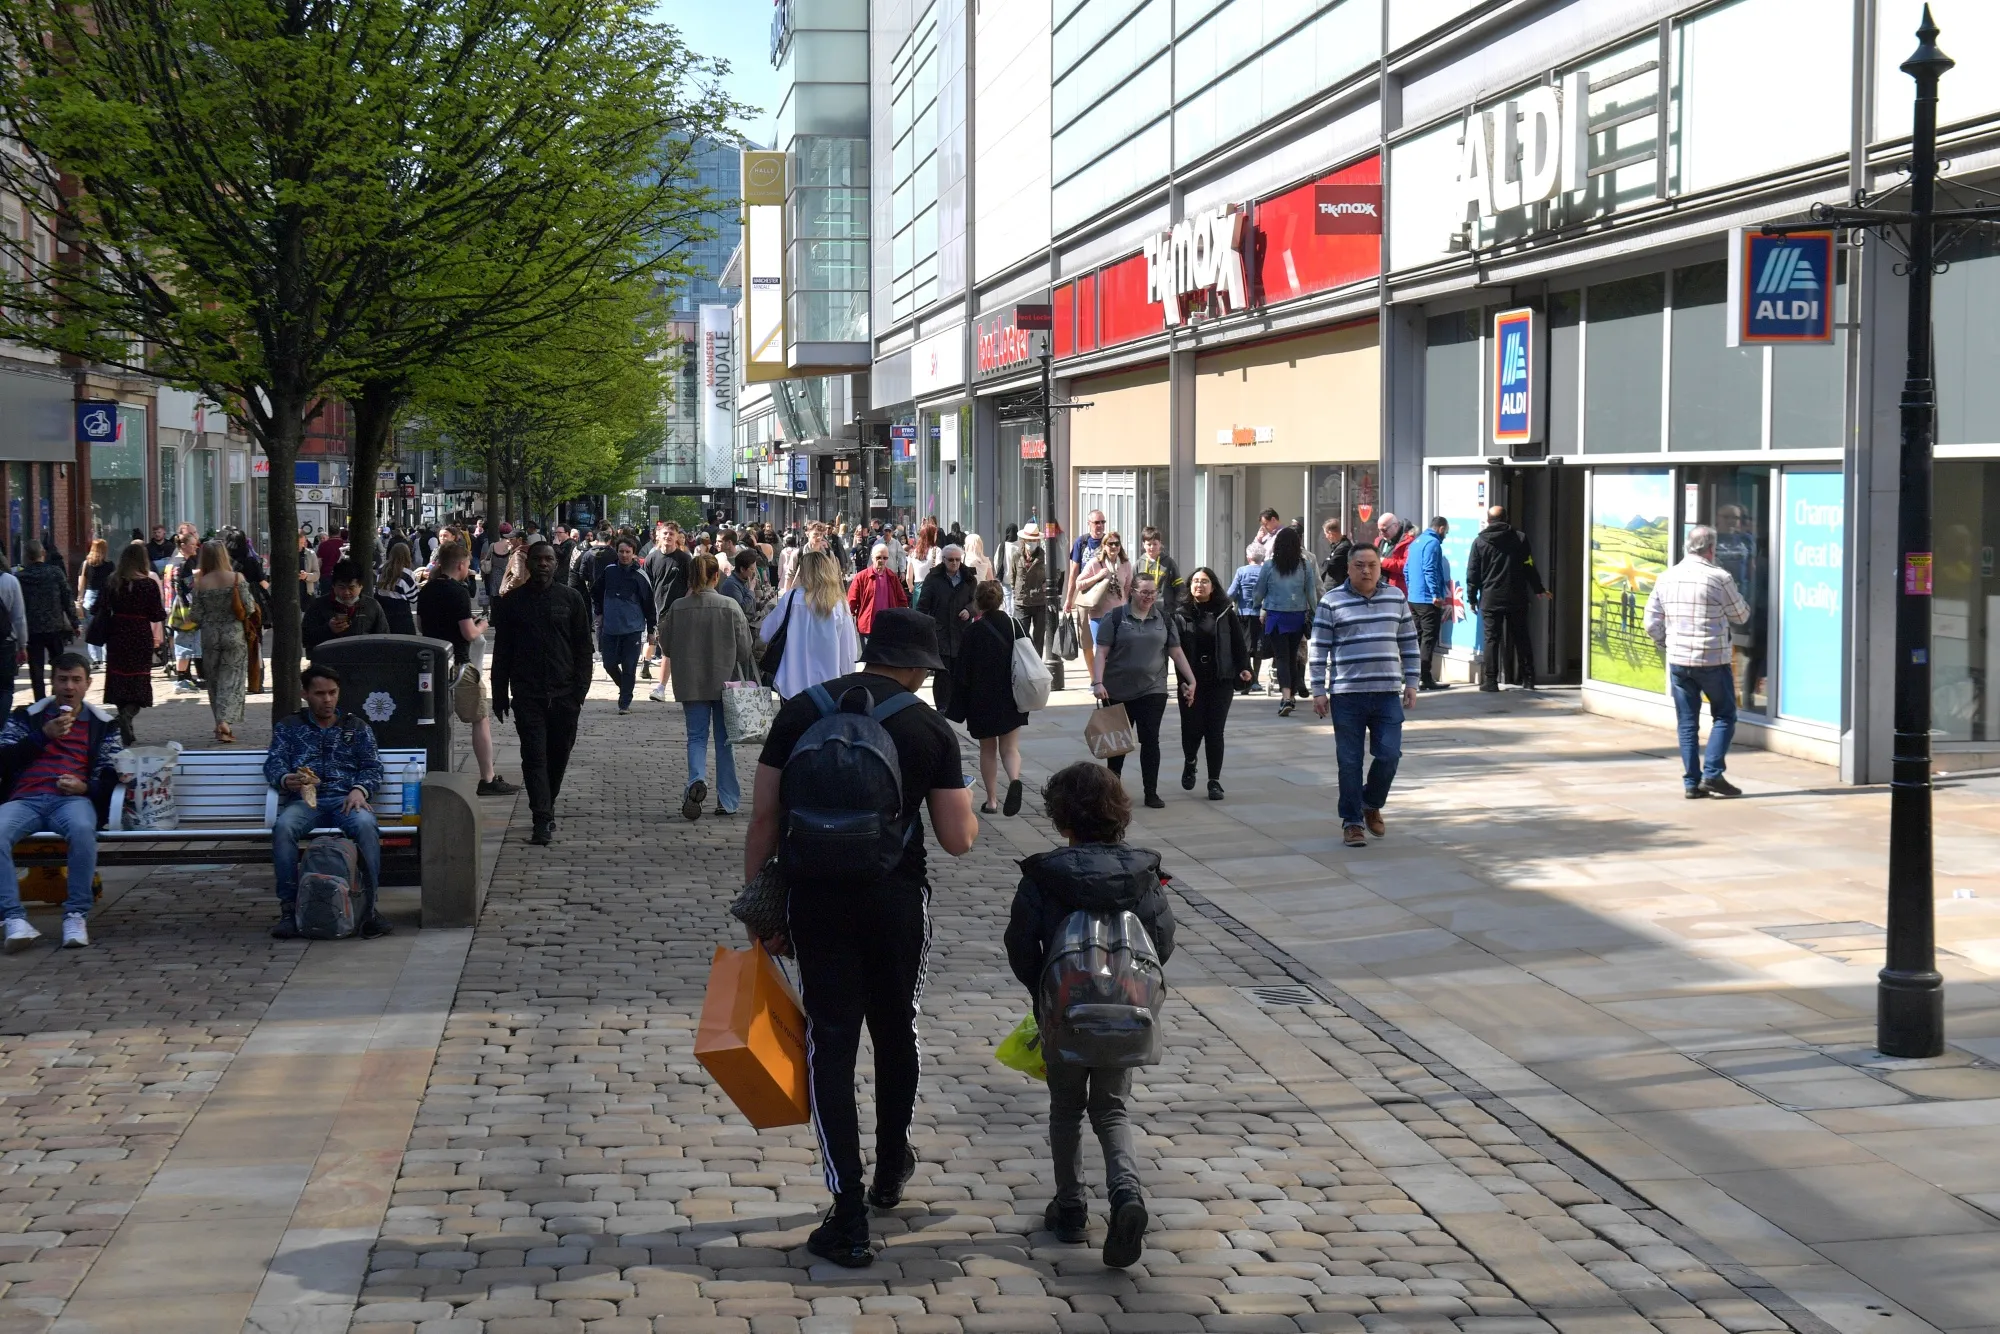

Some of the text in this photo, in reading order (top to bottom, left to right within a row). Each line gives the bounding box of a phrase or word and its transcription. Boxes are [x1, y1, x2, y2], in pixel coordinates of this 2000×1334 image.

[1457, 72, 1588, 223] ALDI
[1755, 300, 1819, 320] ALDI
[706, 331, 715, 387] MANCHESTER
[715, 331, 731, 411] ARNDALE
[1501, 392, 1526, 415] ALDI
[1794, 540, 1827, 566] Great
[1794, 581, 1839, 617] Quality.
